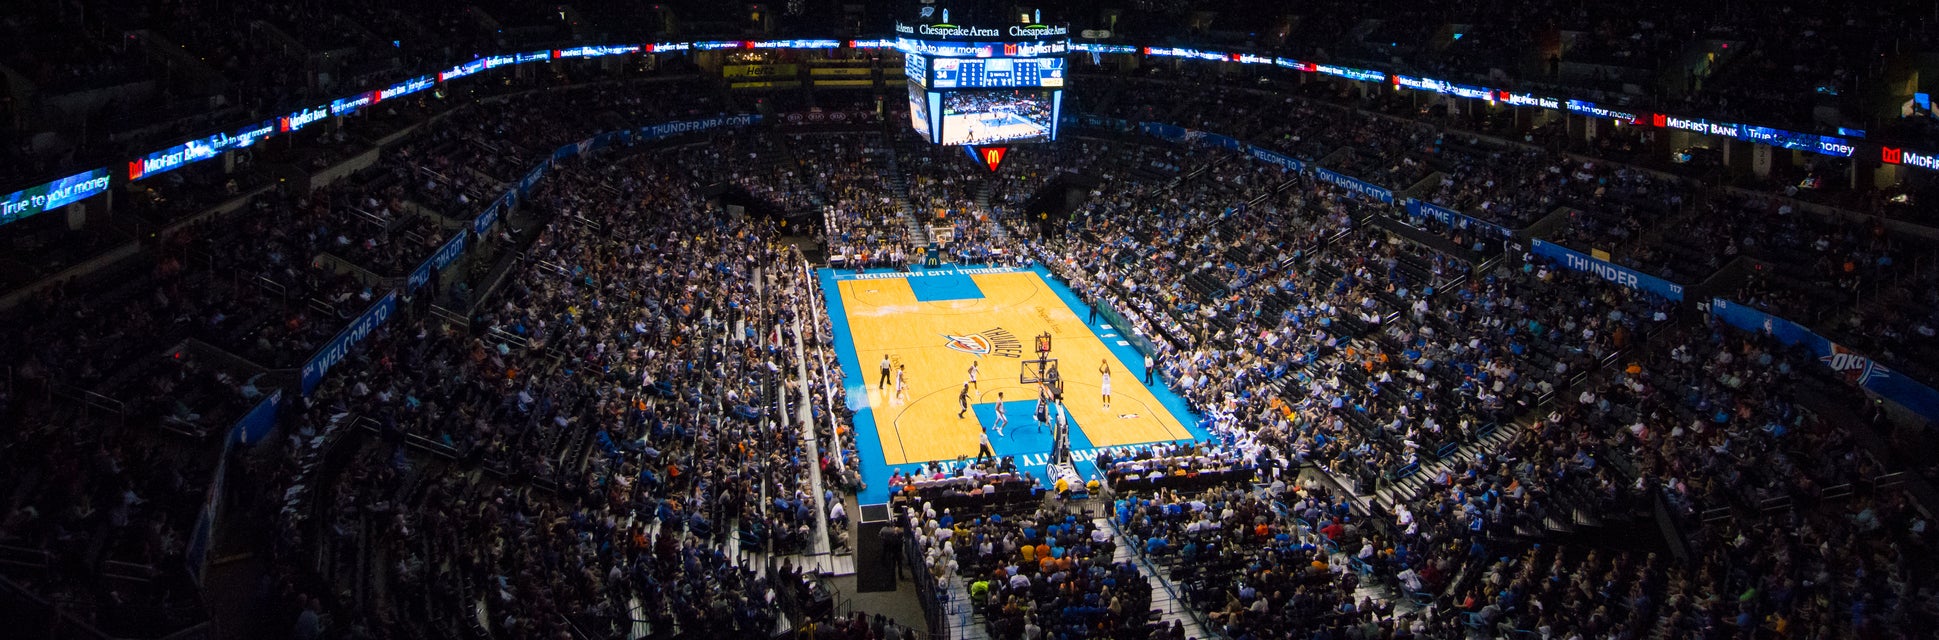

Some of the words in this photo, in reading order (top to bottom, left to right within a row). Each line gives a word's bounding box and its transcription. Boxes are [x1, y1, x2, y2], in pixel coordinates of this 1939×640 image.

[919, 24, 969, 39] Chesapeake
[968, 26, 999, 37] Arena
[1009, 25, 1054, 39] Chesapeake
[928, 45, 937, 53] to
[957, 46, 989, 54] money
[747, 65, 776, 76] Hertz
[937, 70, 948, 79] 34
[1539, 97, 1558, 109] BANK
[1591, 107, 1608, 117] your
[1609, 111, 1637, 124] money
[1666, 117, 1709, 133] MIDFIRST
[1711, 123, 1738, 137] BANK
[1253, 150, 1286, 166] WELCOME
[1286, 159, 1297, 171] TO
[1320, 171, 1363, 194] OKLAHOMA
[1365, 186, 1387, 200] CITY
[1, 200, 29, 216] True
[31, 194, 46, 208] to
[46, 186, 73, 208] your
[74, 174, 110, 195] money
[451, 238, 464, 258] CITY
[856, 270, 925, 280] OKLAHOMA
[926, 268, 953, 277] CITY
[1566, 253, 1639, 289] THUNDER
[1669, 284, 1683, 295] 117
[318, 316, 372, 378] WELCOME
[374, 303, 387, 327] TO
[1830, 352, 1865, 372] OKC
